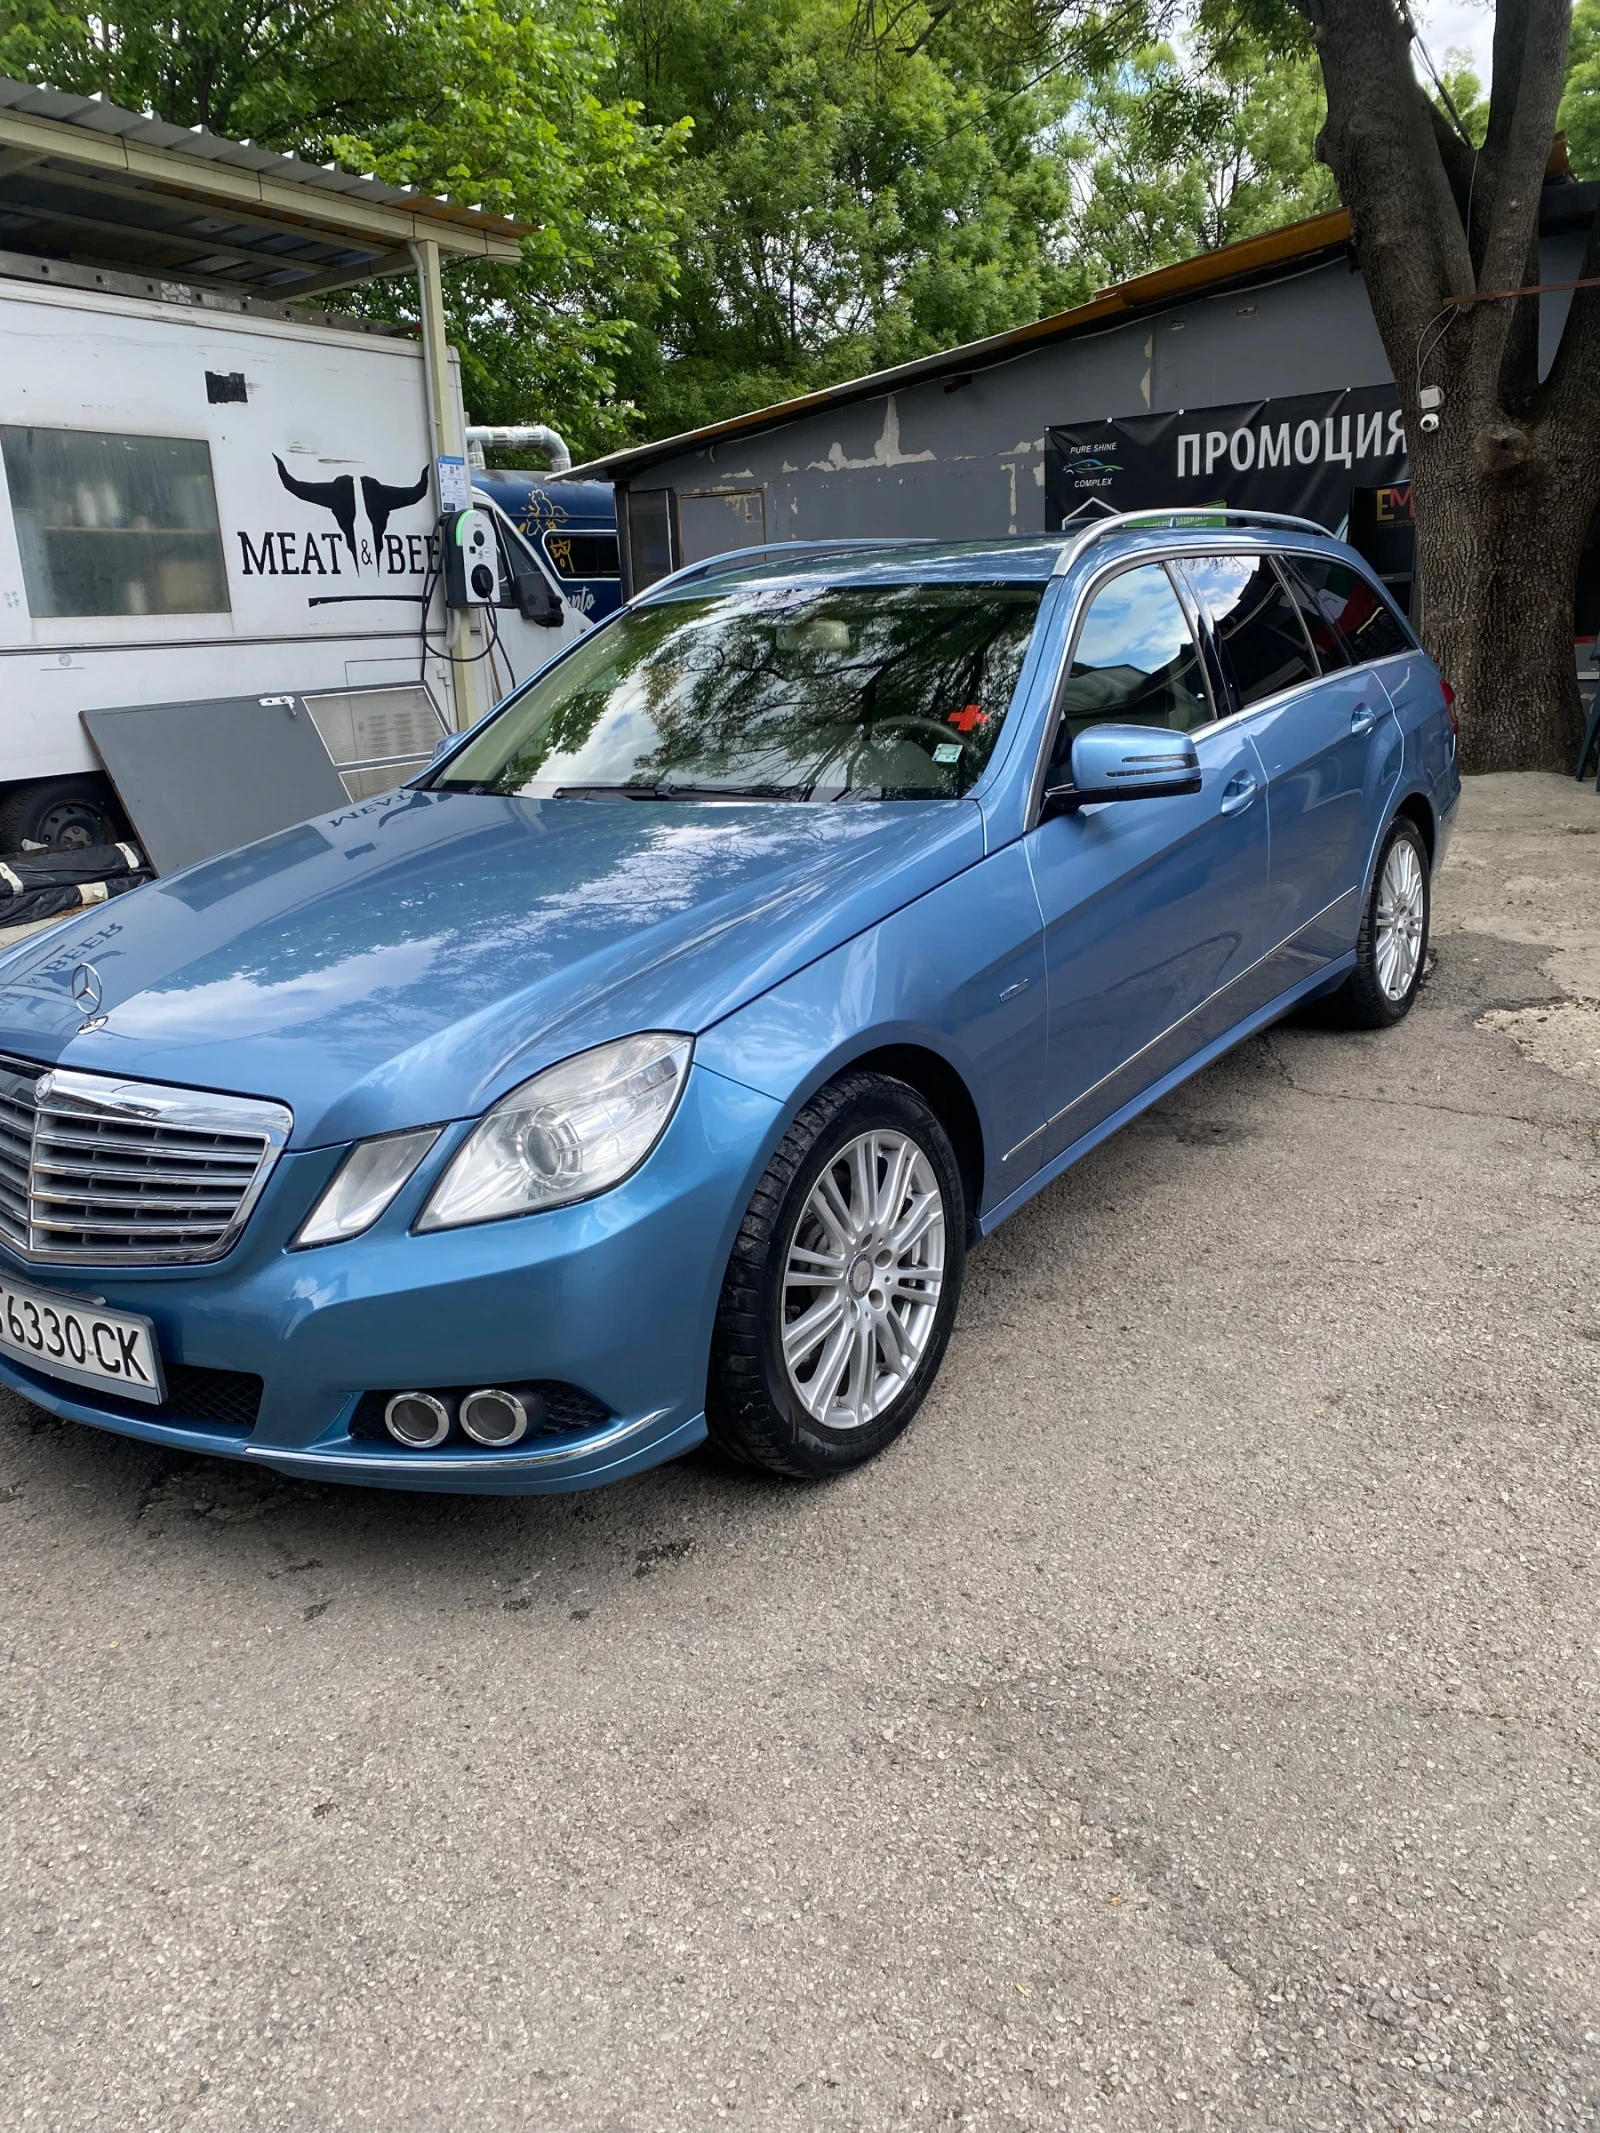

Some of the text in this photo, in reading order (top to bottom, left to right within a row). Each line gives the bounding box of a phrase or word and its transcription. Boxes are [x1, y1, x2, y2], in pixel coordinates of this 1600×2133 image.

[1070, 442, 1117, 454] PURE SHINE
[1177, 409, 1407, 477] ПРОМОЦИЯ
[1074, 478, 1112, 488] COMPLEX
[237, 531, 443, 575] MEAT & BEE
[568, 586, 596, 614] nto
